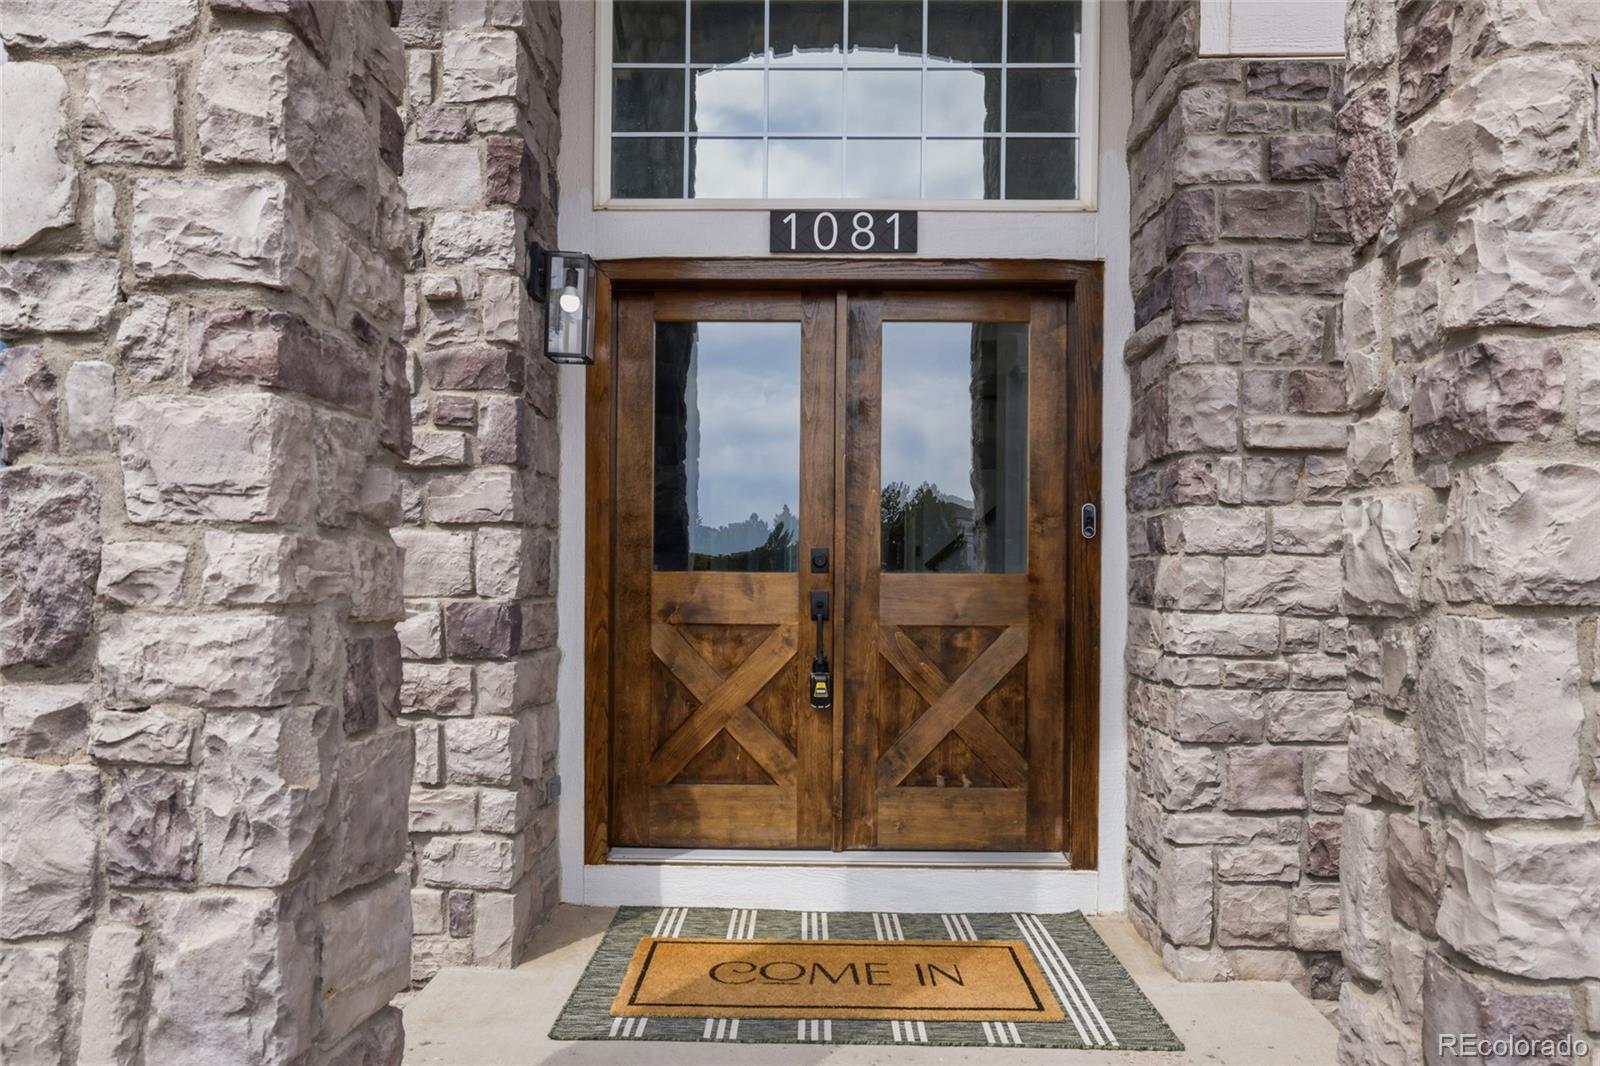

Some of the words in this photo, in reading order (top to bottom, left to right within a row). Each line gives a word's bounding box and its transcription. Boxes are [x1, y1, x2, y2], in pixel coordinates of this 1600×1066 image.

[783, 212, 900, 250] 1081
[709, 961, 892, 986] COME
[915, 963, 965, 986] IN
